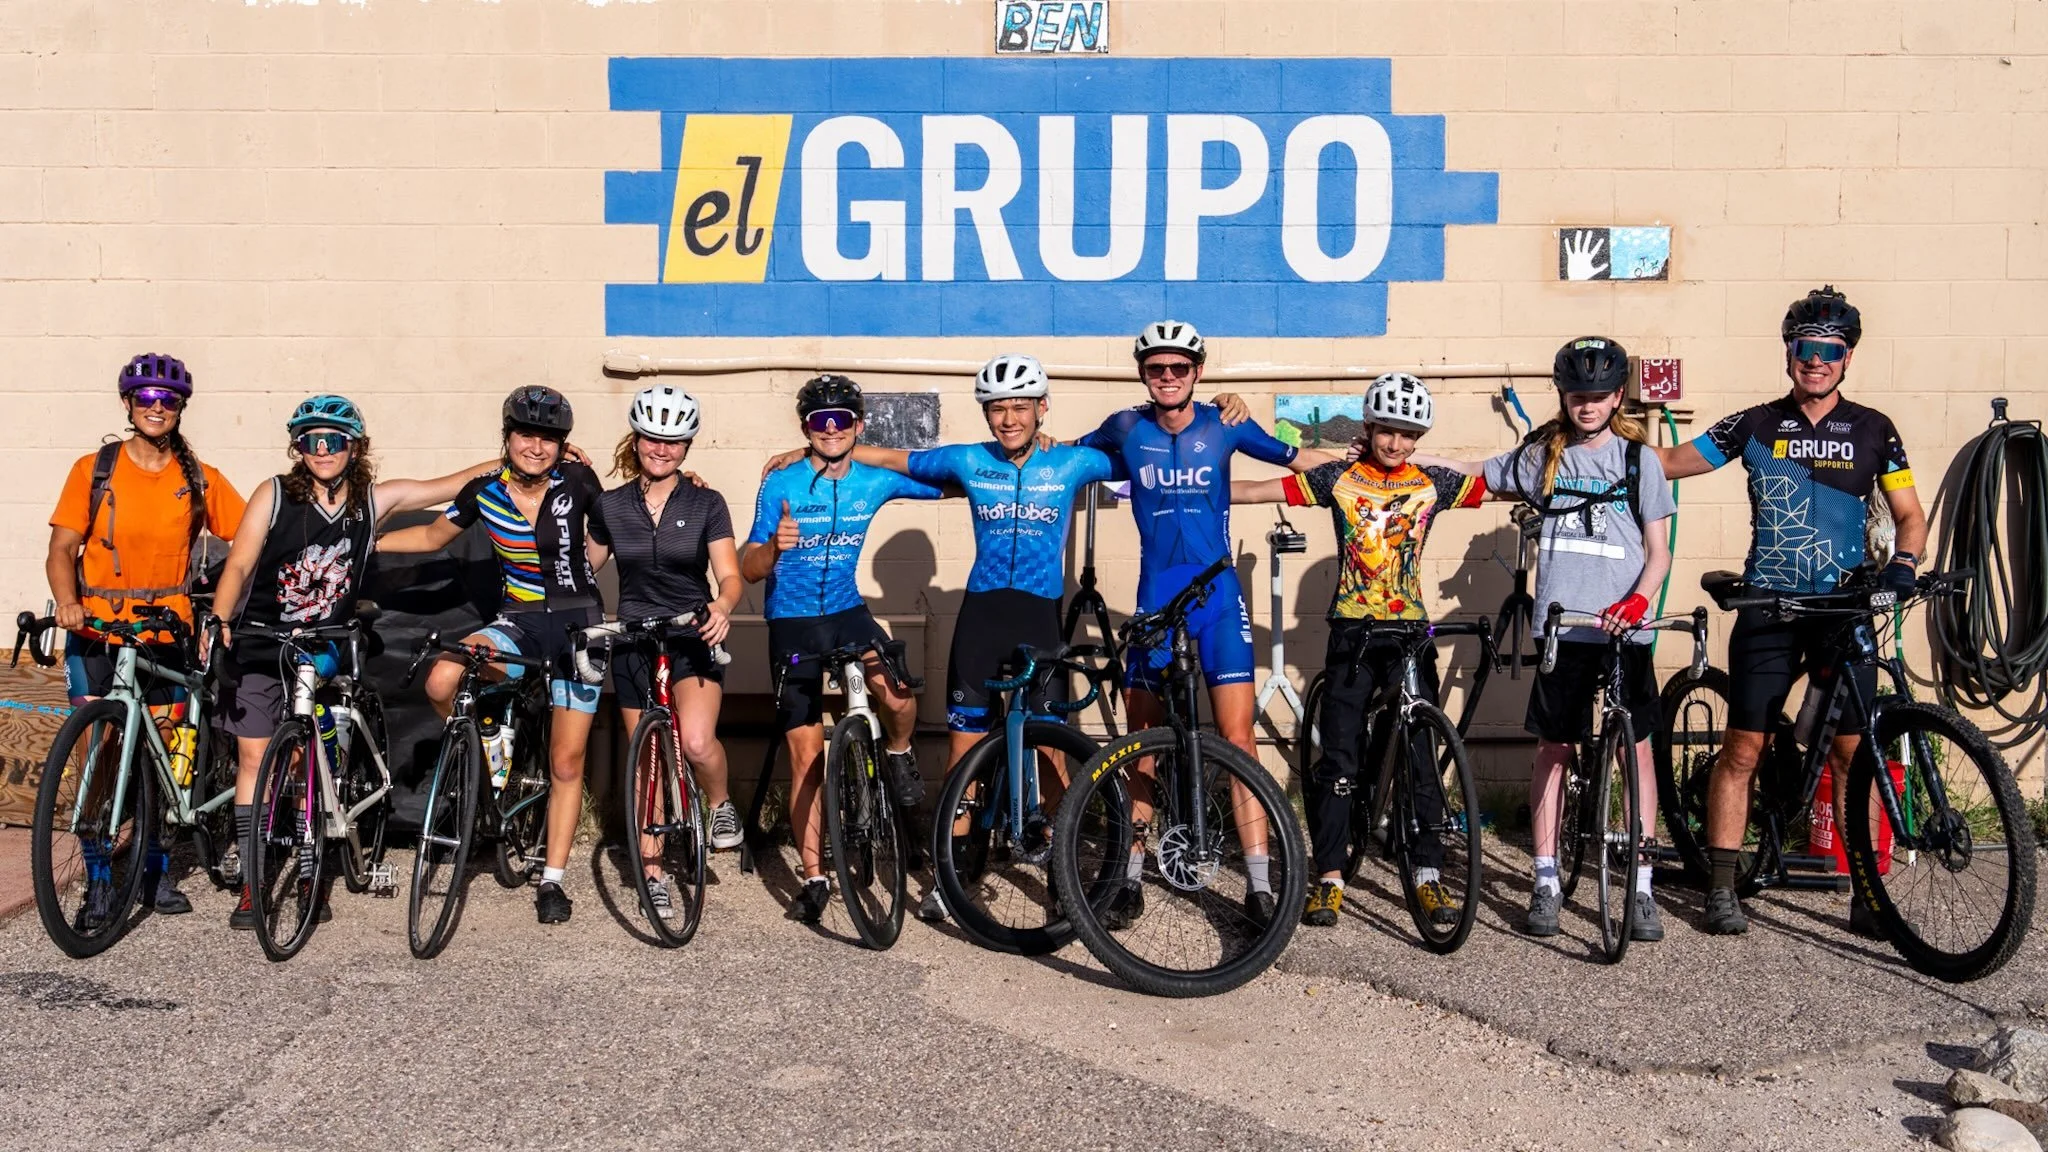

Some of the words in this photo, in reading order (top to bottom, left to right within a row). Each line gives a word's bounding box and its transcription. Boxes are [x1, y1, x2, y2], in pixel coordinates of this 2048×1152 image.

[999, 2, 1102, 52] BEN
[683, 155, 763, 257] el
[800, 113, 1392, 283] GRUPO
[1825, 420, 1853, 429] JACKSON
[1788, 439, 1854, 461] GRUPO
[1814, 459, 1854, 470] SUPPORTER
[974, 467, 1010, 481] LAZER
[1157, 466, 1213, 487] UHC
[968, 479, 1015, 491] SHIMANO
[1027, 482, 1065, 492] wahoo
[795, 504, 828, 514] LAZER
[792, 515, 832, 524] HIMANO
[556, 518, 578, 592] PIVOT
[1216, 671, 1251, 681] ORBEA
[1091, 741, 1142, 783] MAXXIS
[1854, 850, 1881, 912] MAXXIS
